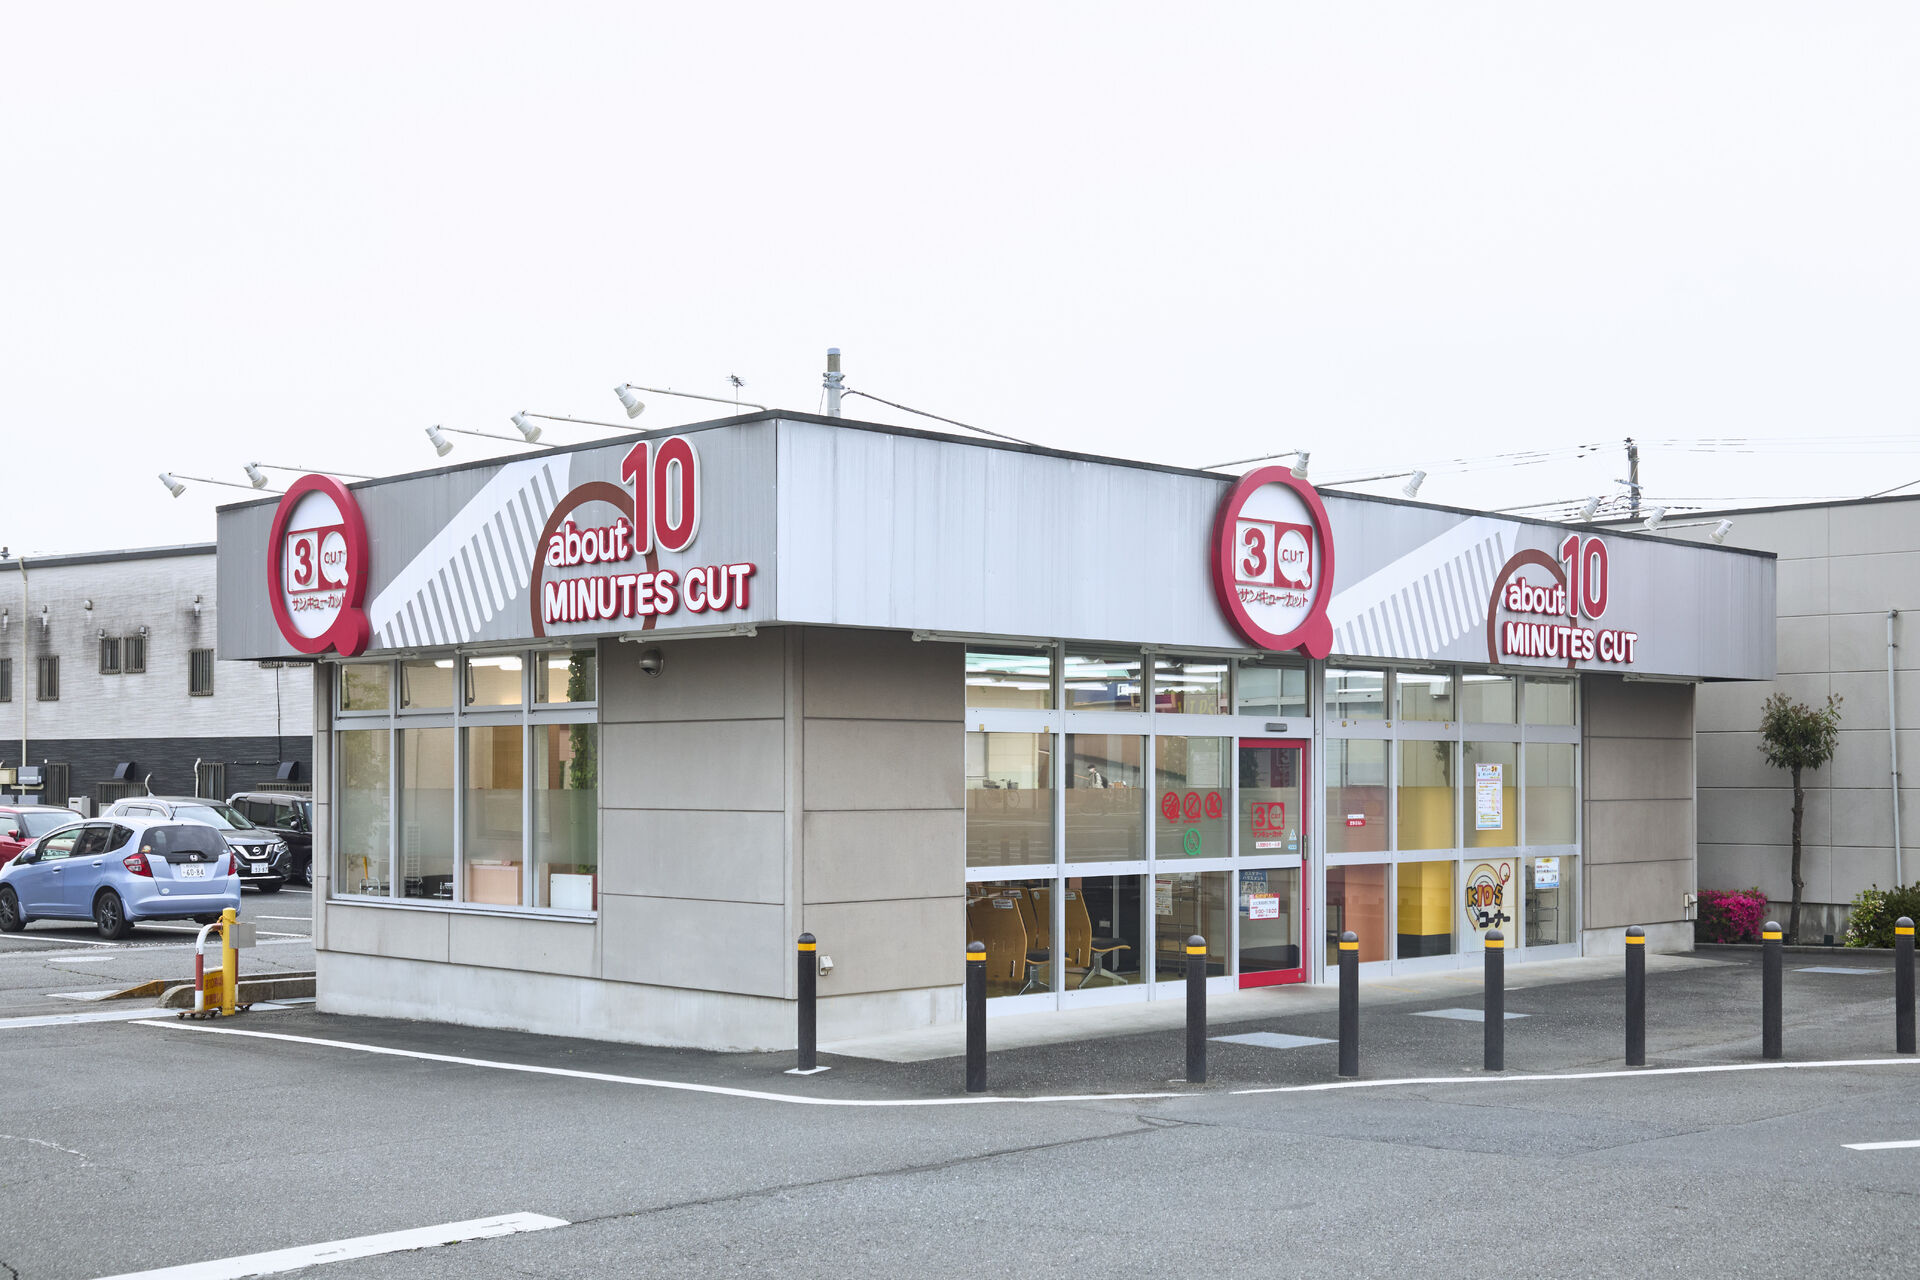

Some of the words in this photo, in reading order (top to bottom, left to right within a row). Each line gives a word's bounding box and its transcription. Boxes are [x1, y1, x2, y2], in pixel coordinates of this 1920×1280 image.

[546, 517, 633, 567] about
[621, 435, 700, 554] 10
[324, 550, 343, 564] CUT
[1282, 549, 1305, 562] CUT
[1505, 577, 1566, 616] about
[1559, 534, 1609, 620] 10
[545, 569, 680, 624] MINUTES
[683, 562, 757, 614] CUT
[1240, 588, 1308, 607] サンキューカット
[1503, 621, 1595, 661] MINUTES
[1597, 629, 1639, 664] CUT
[1467, 883, 1503, 907] KIDS
[1479, 910, 1511, 929] コーナー
